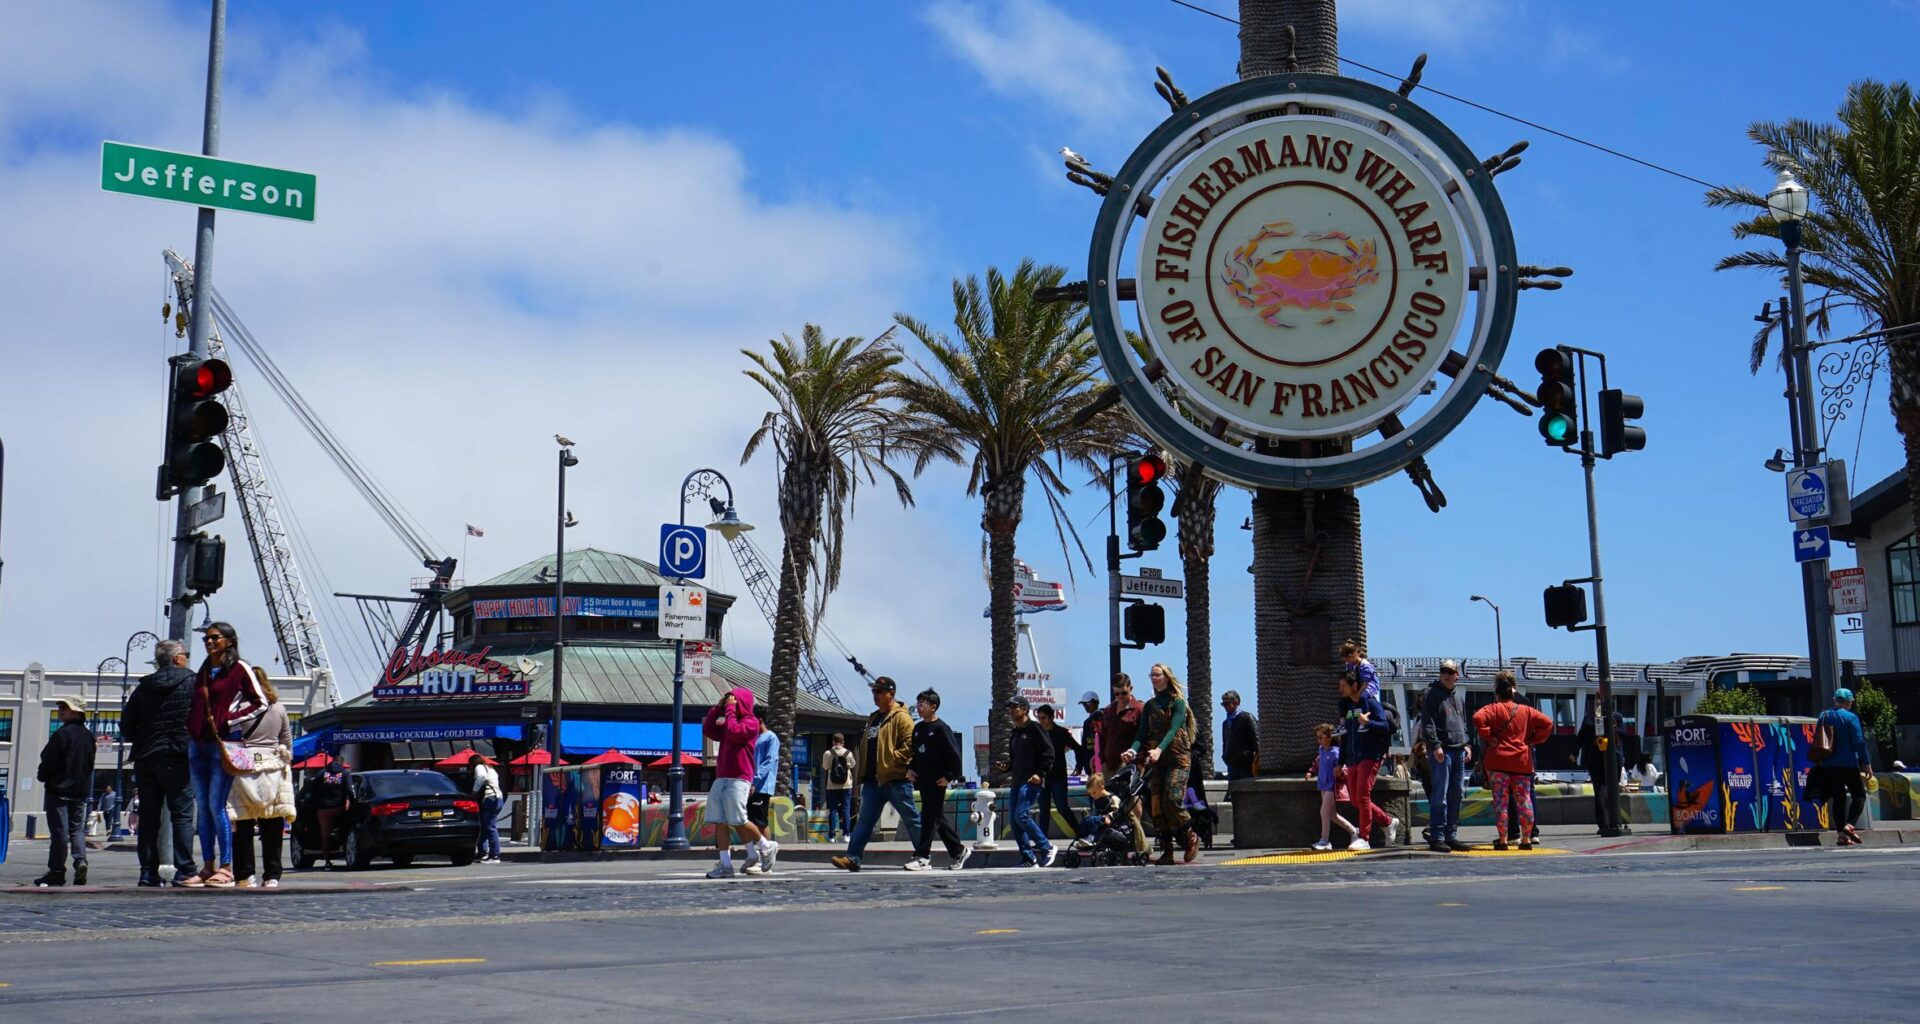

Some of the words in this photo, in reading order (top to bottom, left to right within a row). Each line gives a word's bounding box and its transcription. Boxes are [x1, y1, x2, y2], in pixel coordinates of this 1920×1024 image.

[114, 158, 303, 208] Jefferson
[1155, 133, 1353, 283] FISHERMANS
[1353, 148, 1450, 275] WHARF
[1160, 298, 1207, 345] OF
[1191, 346, 1266, 409] SAN
[1269, 290, 1447, 418] FRANCISCO
[1127, 580, 1177, 594] Jefferson
[1842, 588, 1856, 597] ANY
[584, 597, 594, 606] $5
[1841, 597, 1858, 606] TIME
[473, 600, 507, 619] HAPPY
[508, 598, 536, 618] HOUR
[537, 597, 556, 617] ALL
[561, 596, 582, 616] AY!
[664, 613, 702, 622] Fisherman's
[385, 645, 513, 685] Chowder
[422, 669, 477, 694] HUT
[478, 684, 523, 692] GRILL
[333, 732, 374, 741] DUNGENESS
[375, 732, 395, 740] CRAB
[400, 731, 440, 739] COCKTAILS
[444, 730, 464, 738] COLD
[465, 729, 484, 737] BEER
[1675, 728, 1706, 742] PORT
[610, 770, 635, 780] PORT
[1728, 778, 1753, 789] WHARF
[1676, 809, 1718, 820] BOATING
[983, 827, 990, 837] 8
